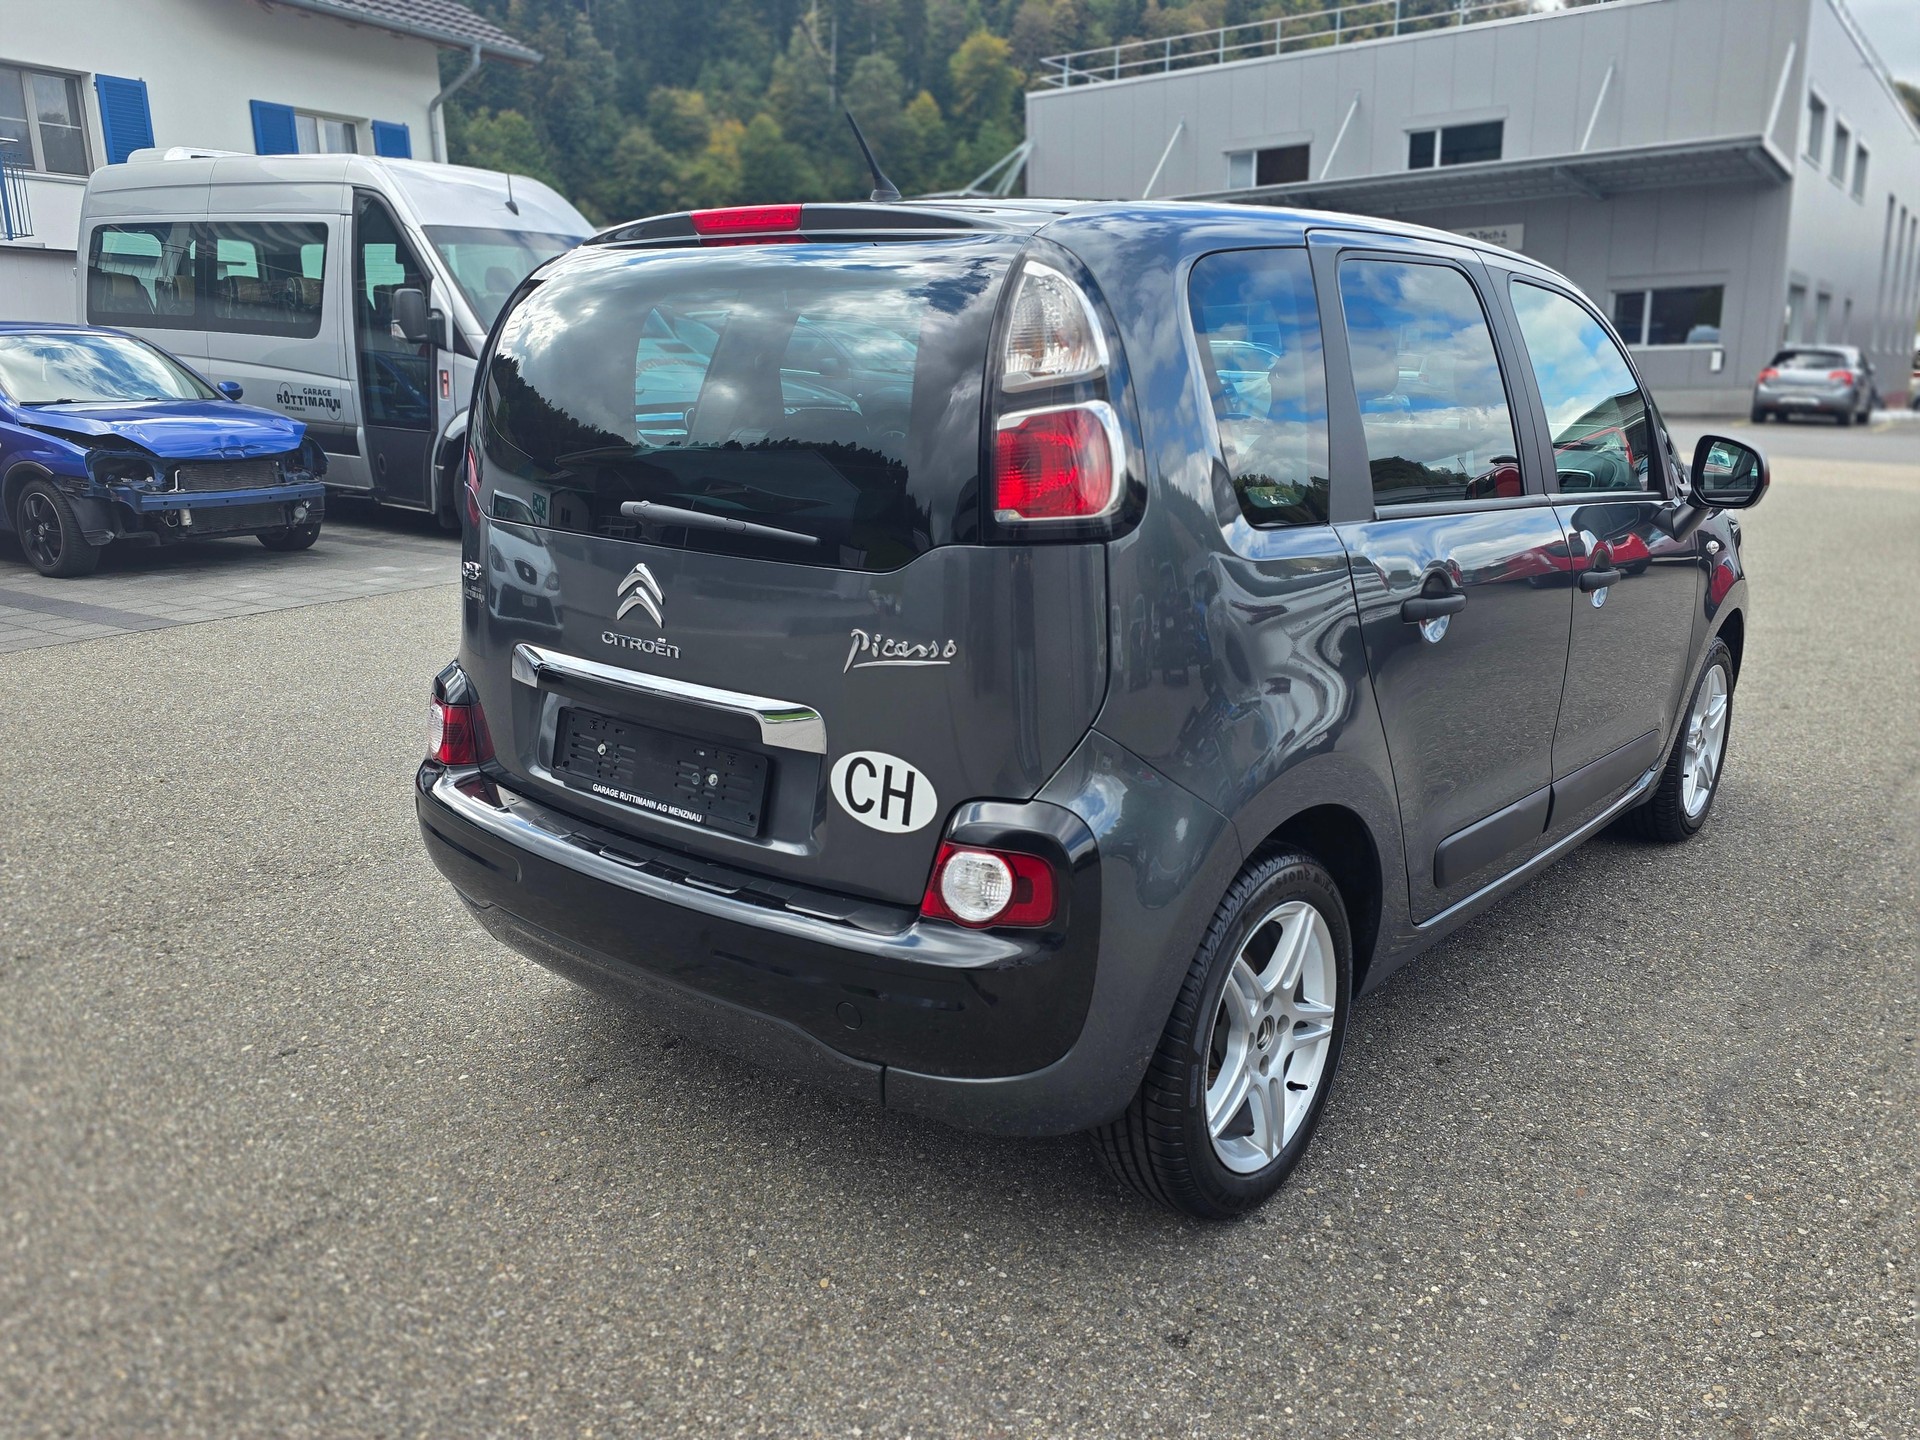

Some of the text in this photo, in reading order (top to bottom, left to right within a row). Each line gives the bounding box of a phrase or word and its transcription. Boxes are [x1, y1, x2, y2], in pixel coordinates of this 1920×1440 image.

[303, 387, 332, 397] GARAGE
[843, 628, 957, 674] Picasso
[592, 783, 619, 798] GARAGE
[656, 802, 668, 813] AG
[668, 805, 702, 822] MENZNAU
[844, 756, 915, 827] CH
